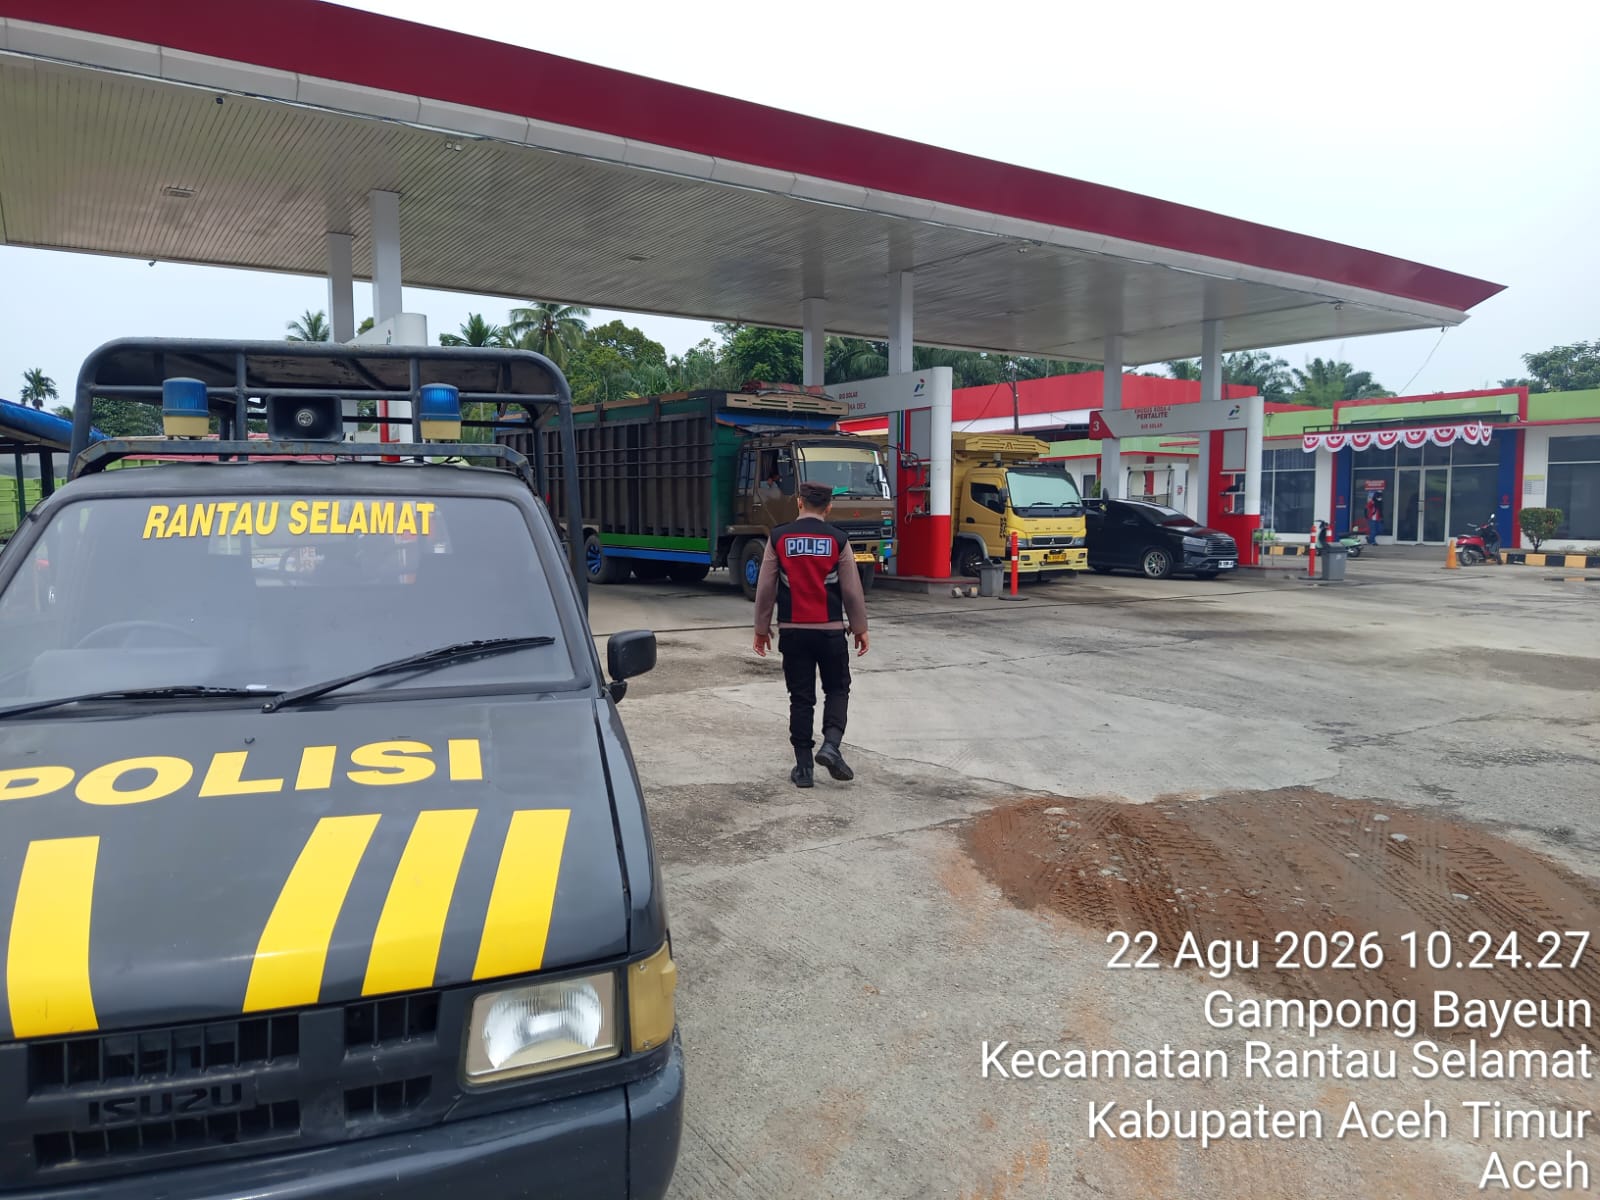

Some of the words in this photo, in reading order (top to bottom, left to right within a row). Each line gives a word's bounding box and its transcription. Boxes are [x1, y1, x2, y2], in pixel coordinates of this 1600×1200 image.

[1093, 421, 1100, 431] 3
[1136, 411, 1169, 420] PERTALITE
[142, 501, 279, 539] RANTAU
[288, 500, 436, 535] SELAMAT
[787, 538, 830, 555] POLISI
[0, 738, 484, 806] POLISI
[88, 1083, 242, 1126] ISUZU
